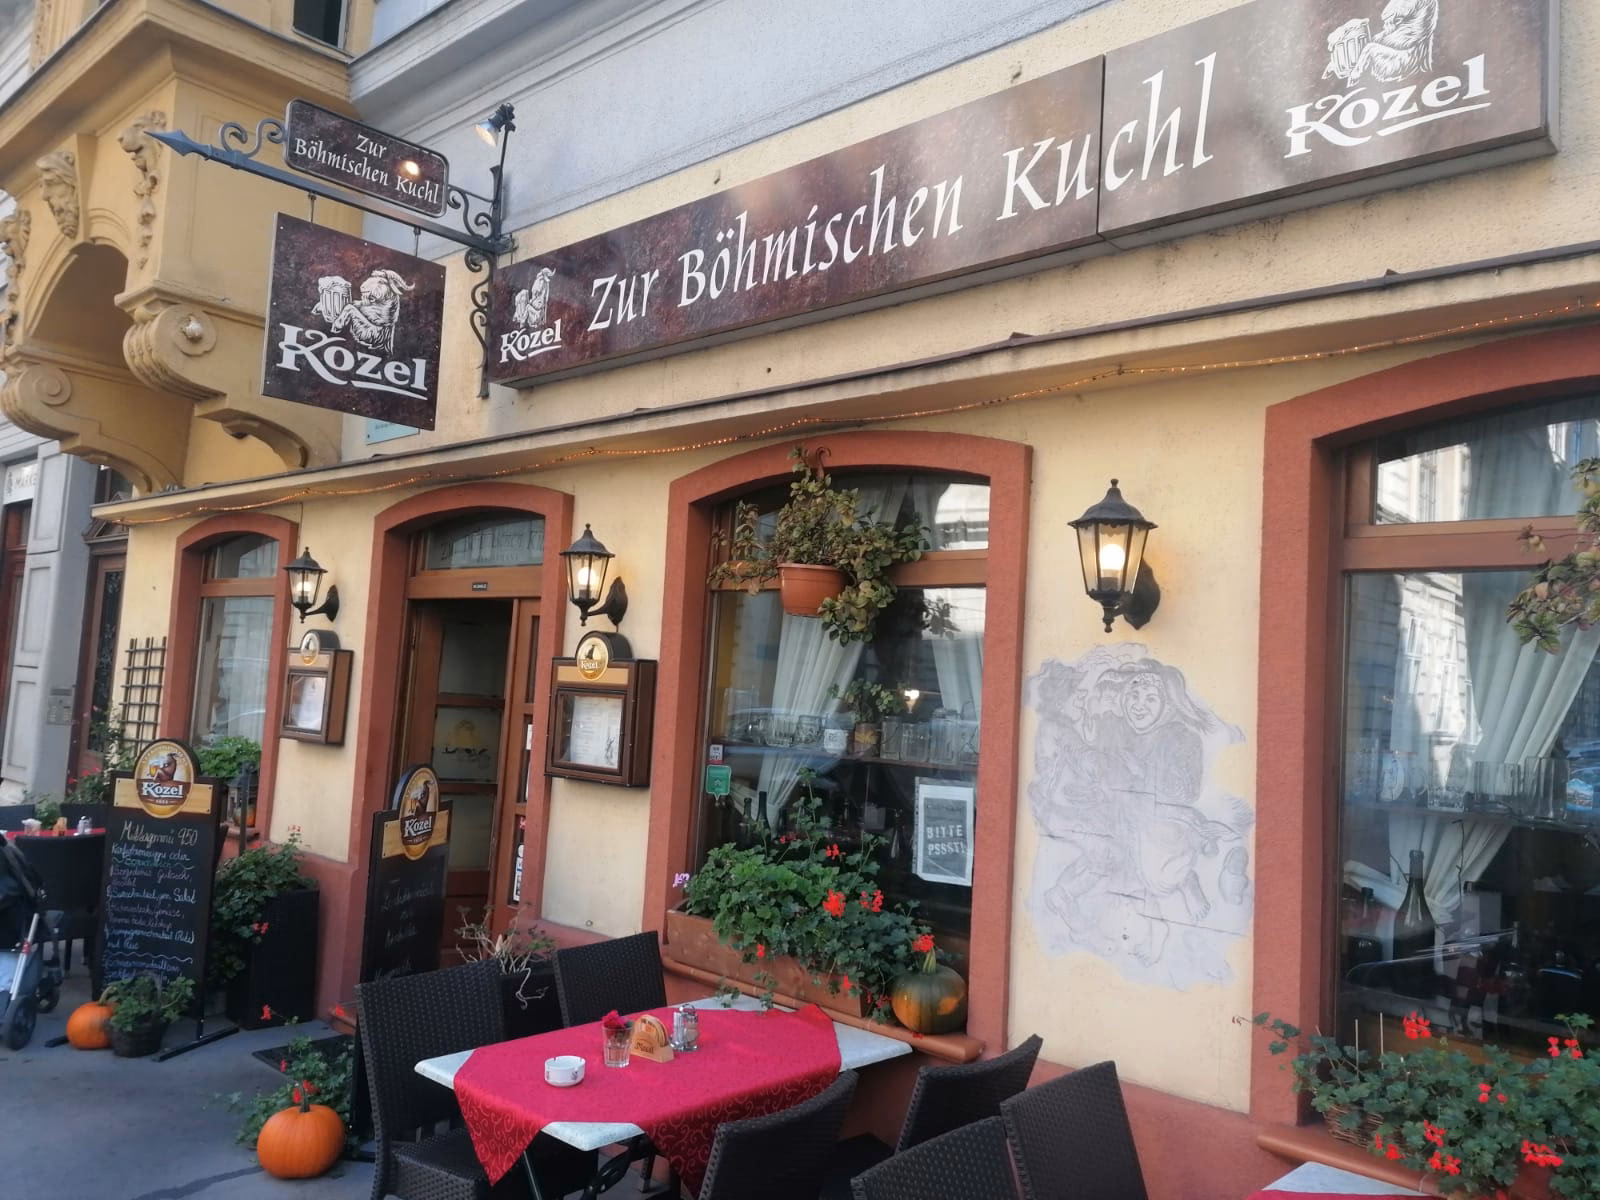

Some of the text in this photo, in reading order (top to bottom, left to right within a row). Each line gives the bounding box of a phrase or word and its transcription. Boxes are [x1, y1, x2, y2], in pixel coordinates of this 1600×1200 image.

[1283, 53, 1491, 160] Kozel
[355, 133, 388, 159] Zur
[294, 137, 440, 205] Böhmischen Kuchl
[587, 52, 1217, 332] Zur Böhmischen Kuchl
[276, 322, 429, 392] Kozel
[500, 318, 562, 364] Kozel
[142, 781, 184, 799] Kozel
[404, 815, 433, 837] Kozel
[926, 824, 963, 839] BITTE
